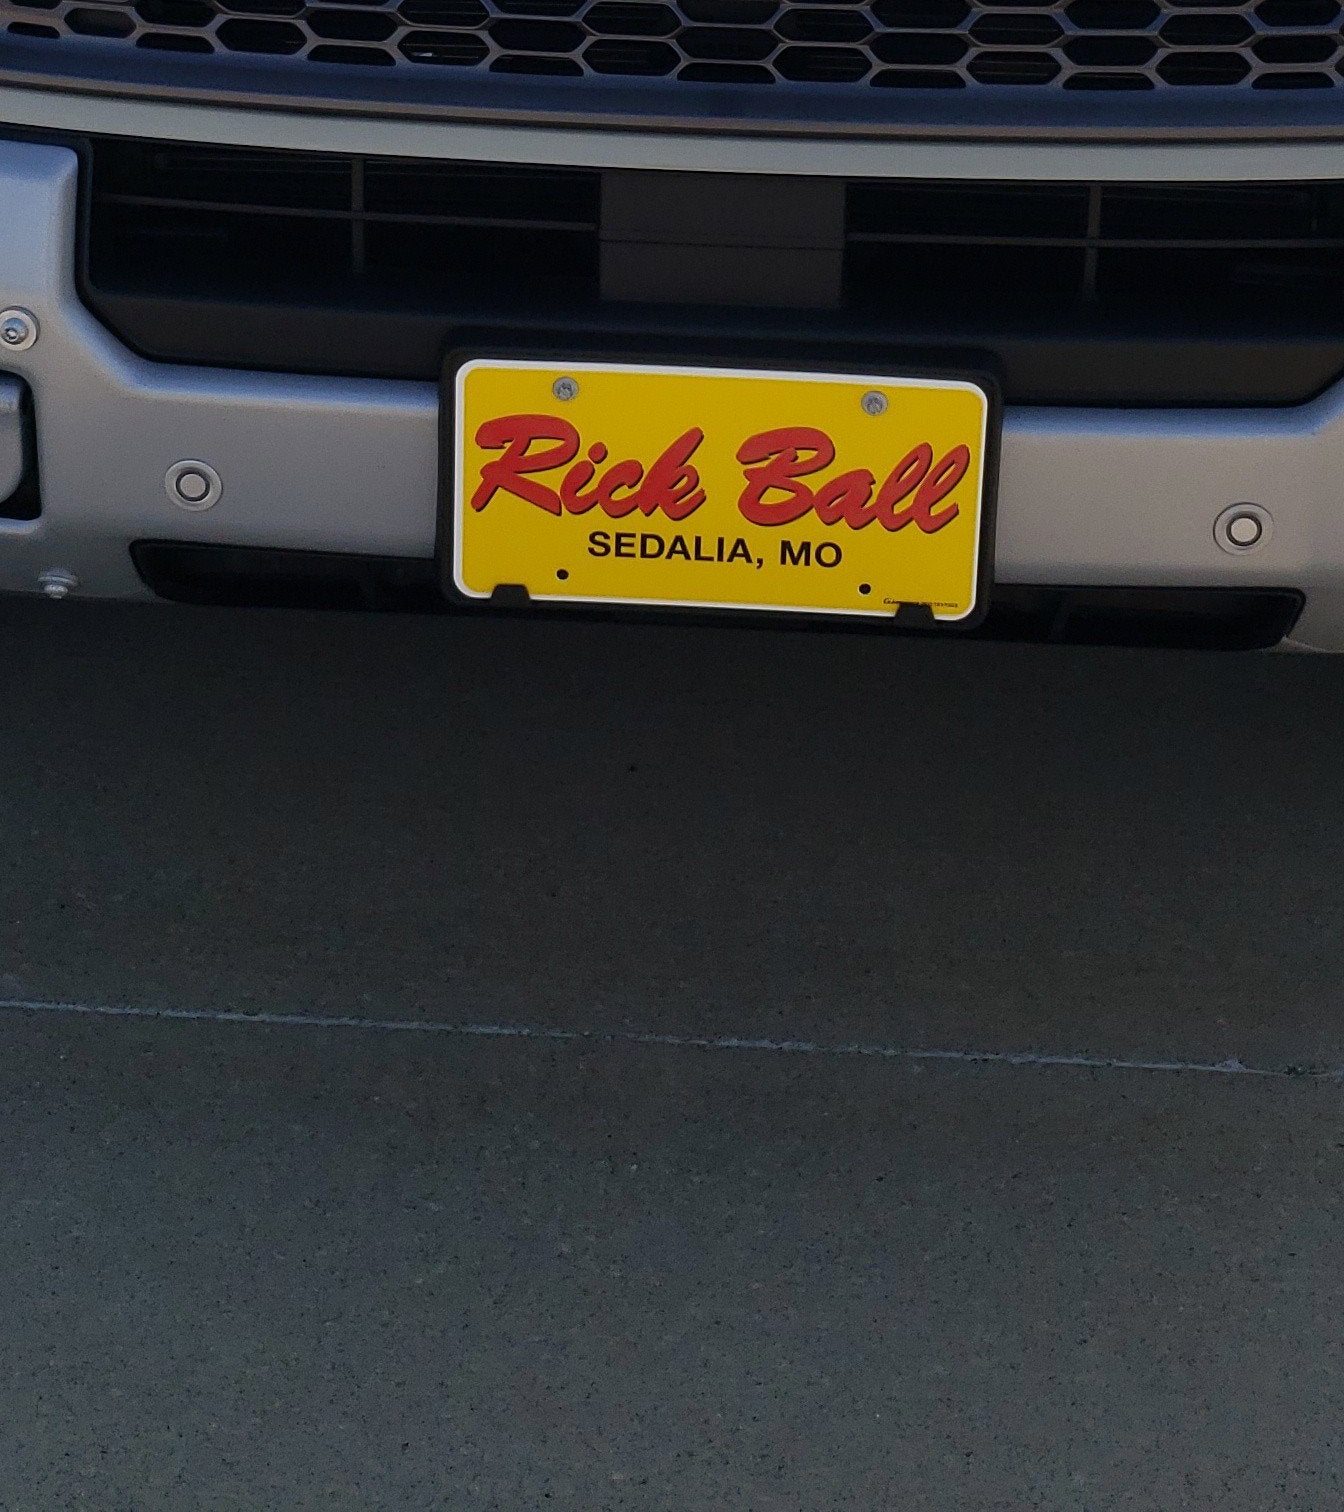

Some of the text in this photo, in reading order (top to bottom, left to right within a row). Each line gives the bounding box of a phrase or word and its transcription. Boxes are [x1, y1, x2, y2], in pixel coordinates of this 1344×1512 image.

[470, 413, 972, 535] Rick Ball
[587, 531, 844, 571] SEDALIA, MO
